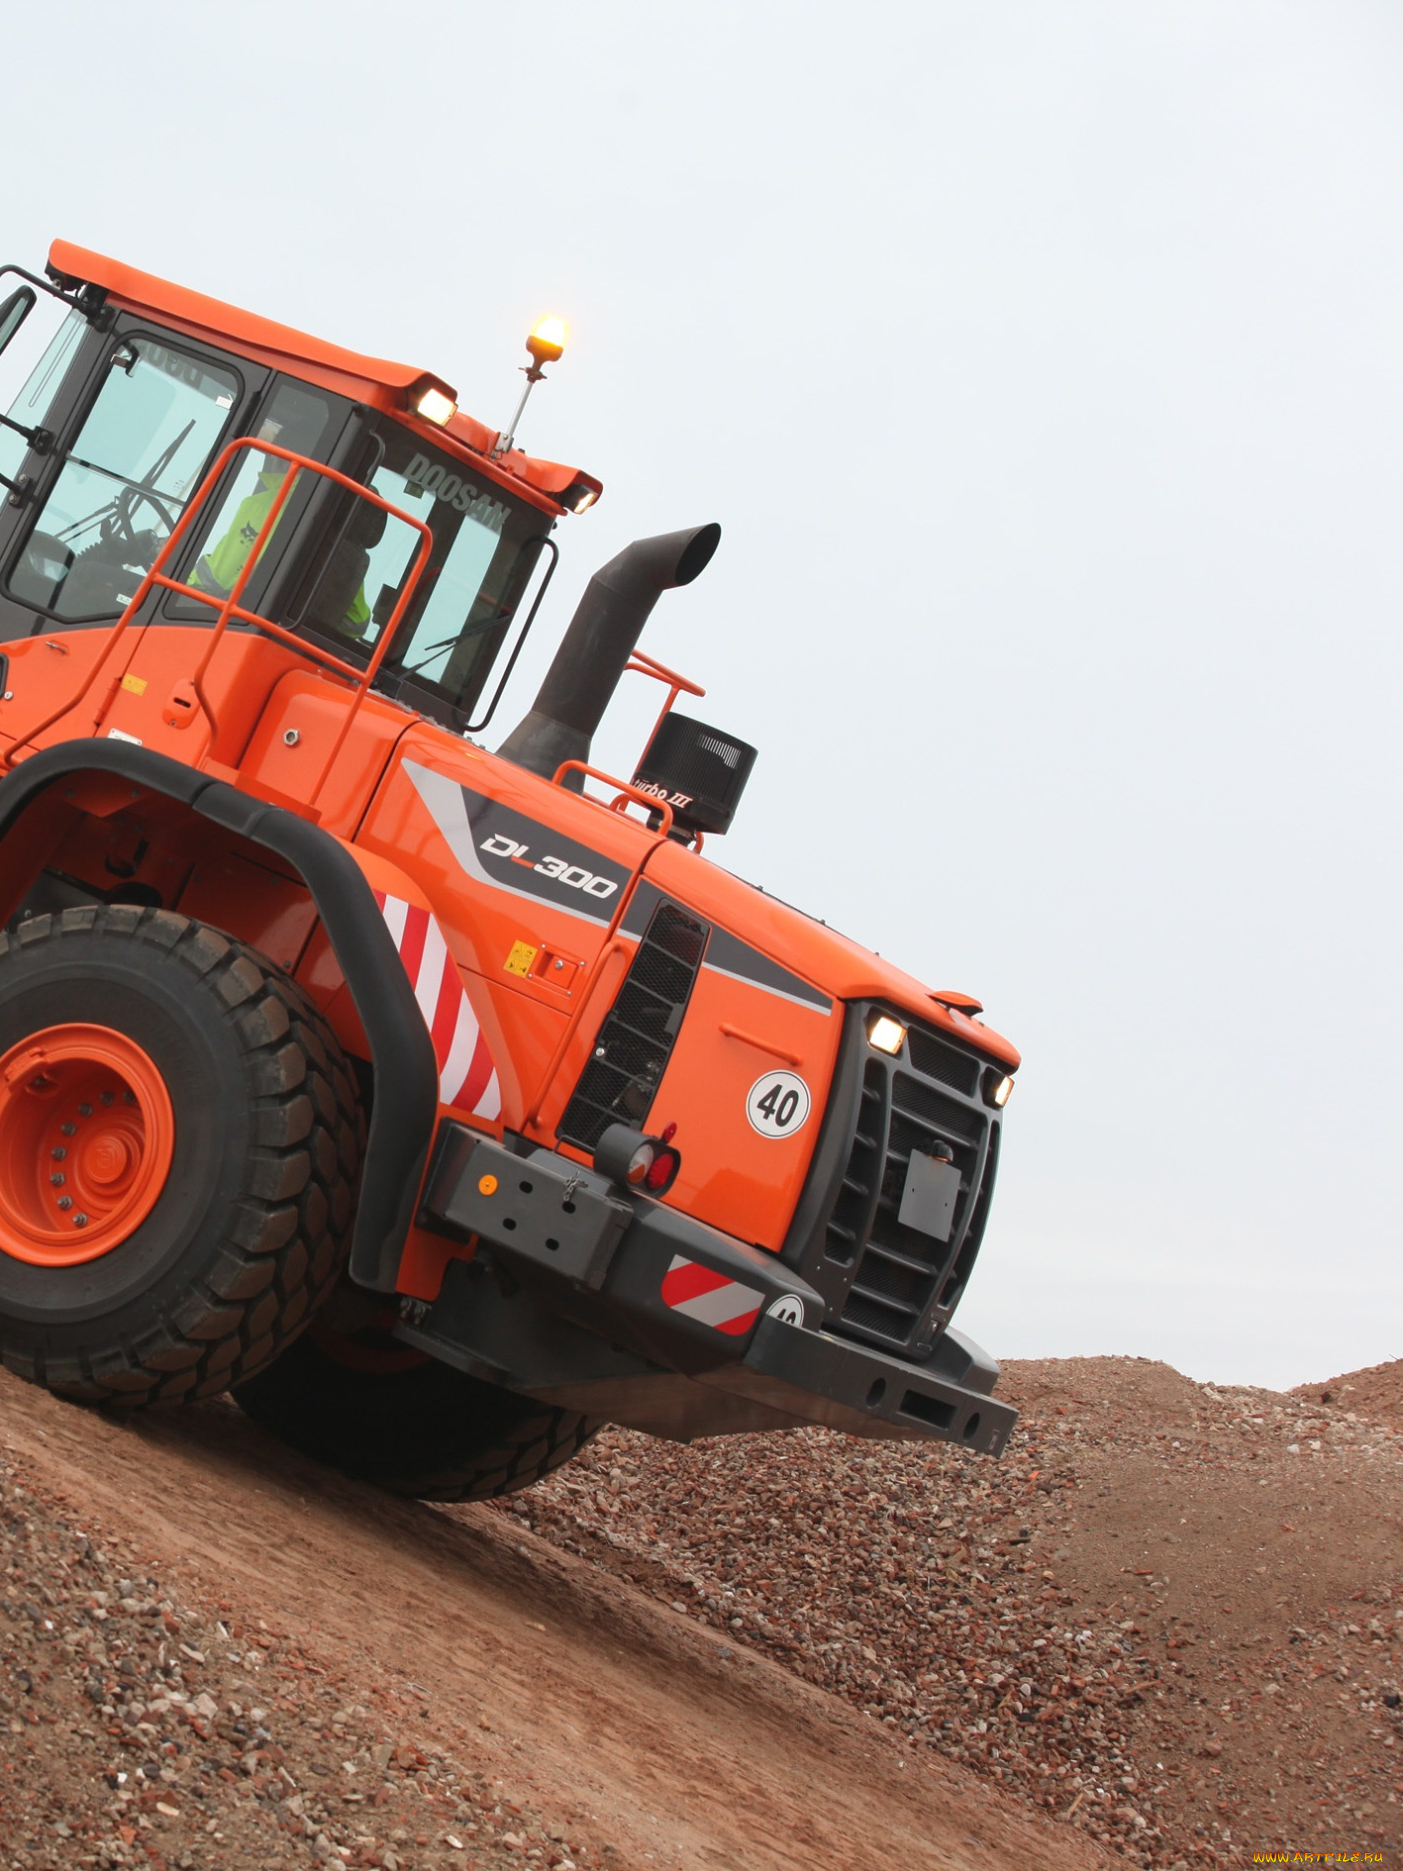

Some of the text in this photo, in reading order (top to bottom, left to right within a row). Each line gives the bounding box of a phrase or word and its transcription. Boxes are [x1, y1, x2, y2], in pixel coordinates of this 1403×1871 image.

[402, 453, 512, 530] DOOSAN
[480, 833, 618, 899] DL300
[757, 1084, 799, 1127] 40
